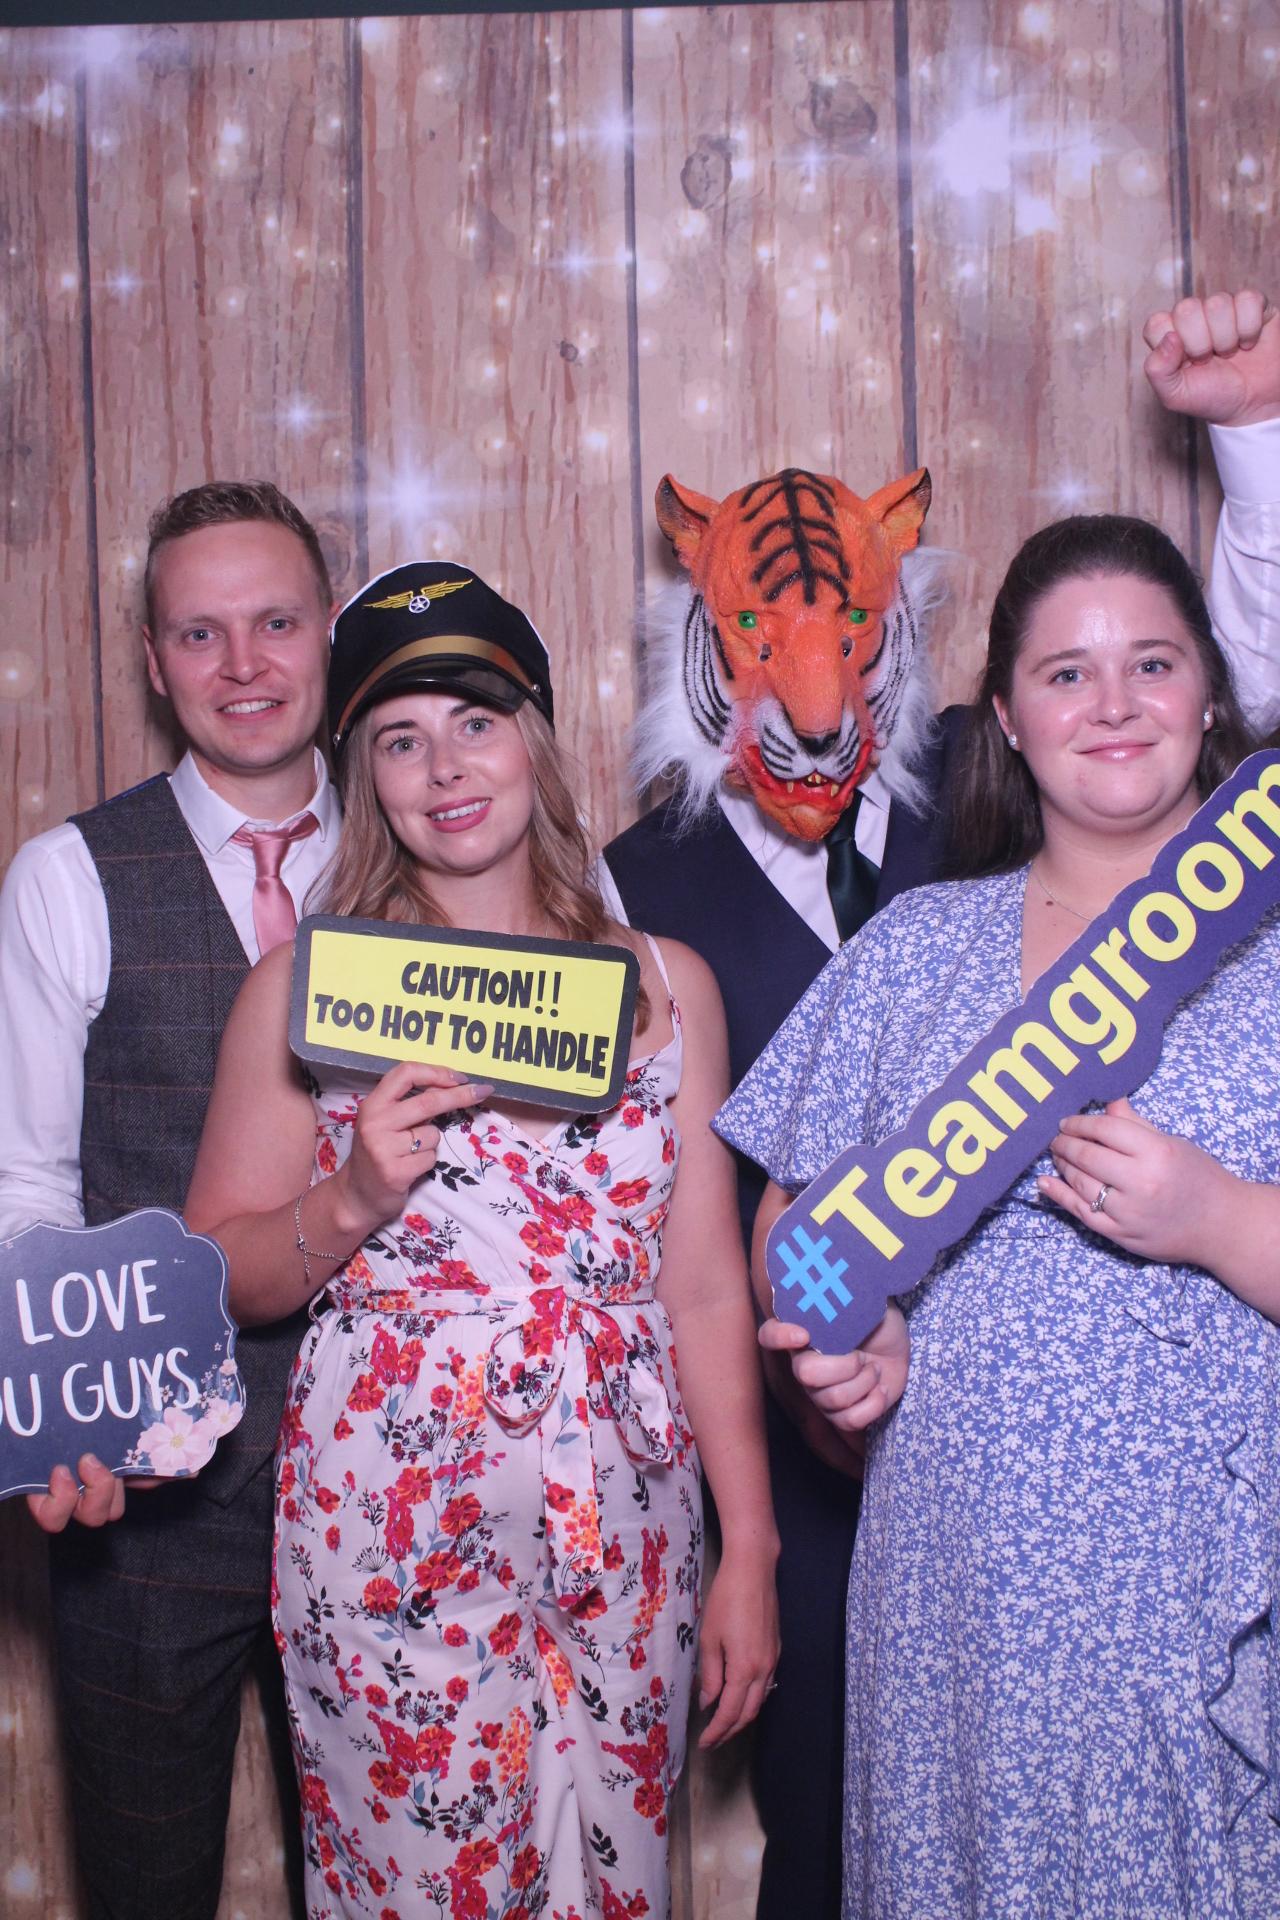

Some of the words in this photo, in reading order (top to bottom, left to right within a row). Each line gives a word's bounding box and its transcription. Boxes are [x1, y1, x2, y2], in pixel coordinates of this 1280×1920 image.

[401, 960, 562, 1018] CAUTION!!
[314, 993, 374, 1032] TOO
[379, 1005, 443, 1045] HOT
[448, 1014, 487, 1054] TO
[492, 1022, 610, 1080] HANDLE
[775, 763, 1280, 1324] #Teamgroom
[16, 1259, 166, 1345] LOVE
[0, 1373, 43, 1437] U
[62, 1347, 200, 1423] GUYS
